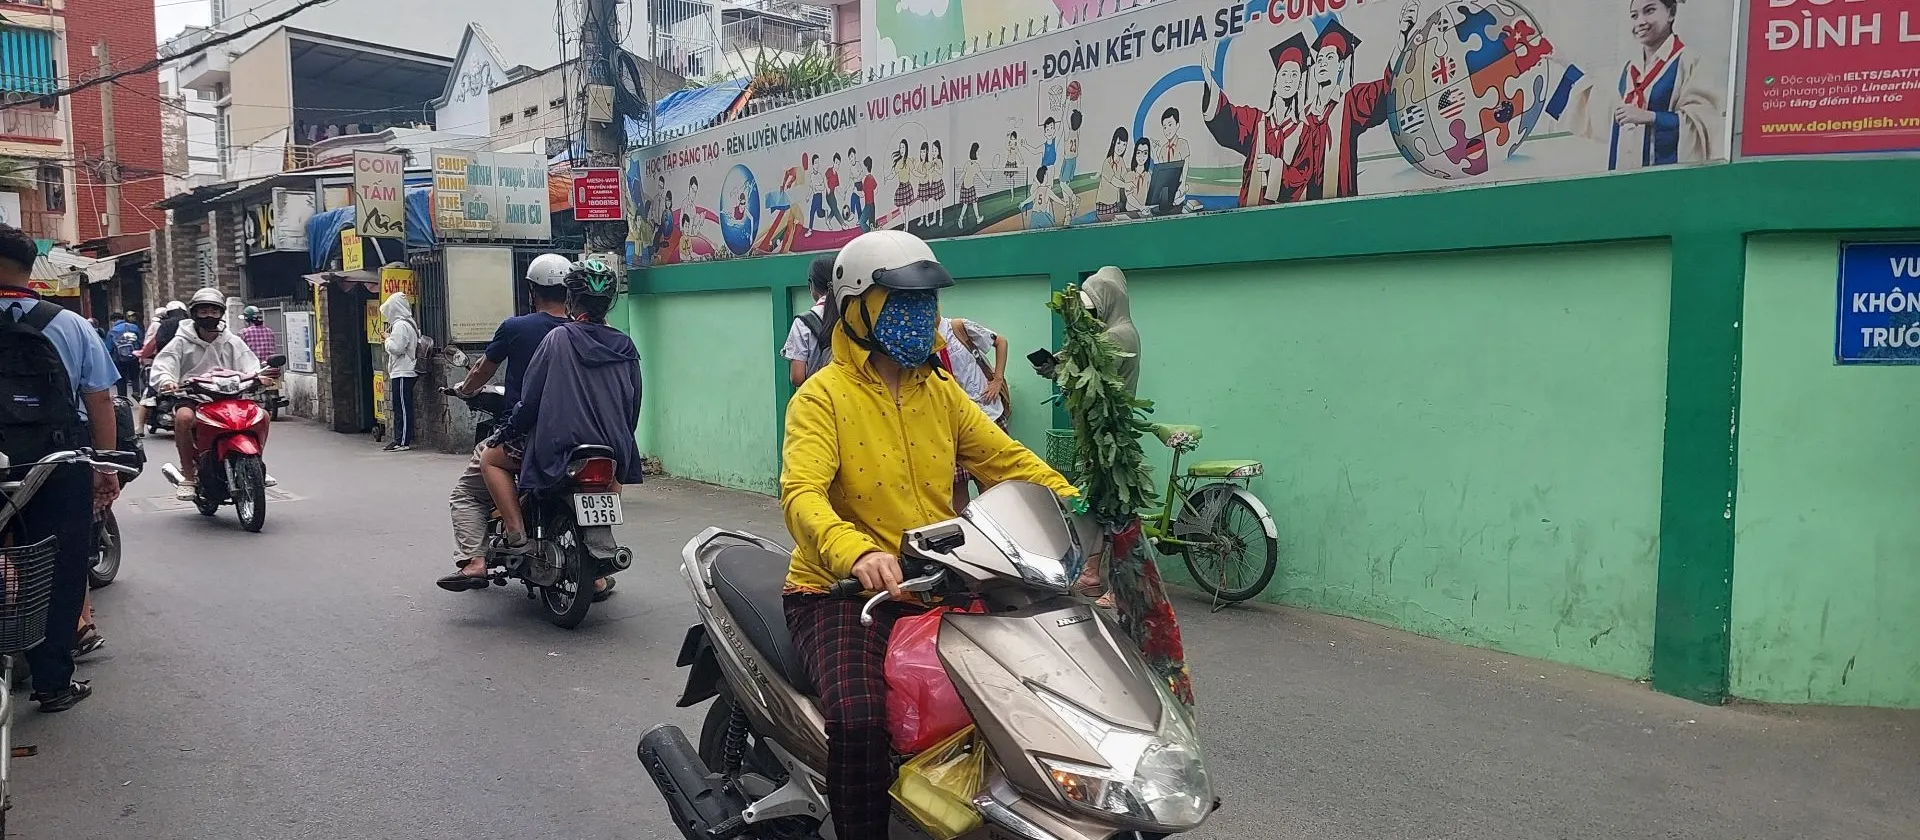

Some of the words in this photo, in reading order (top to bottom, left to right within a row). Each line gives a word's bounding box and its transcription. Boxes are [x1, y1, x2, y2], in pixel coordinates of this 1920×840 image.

[1765, 10, 1881, 50] ĐÌNH
[1781, 75, 1803, 85] Độc
[1806, 72, 1841, 85] quyền
[645, 157, 661, 179] HỌC
[663, 150, 677, 175] TẬP
[679, 145, 700, 167] SÁNG
[702, 141, 720, 166] TẠO
[727, 132, 745, 155] RÈN
[747, 123, 778, 153] LUYỆN
[780, 115, 811, 142] CHĂM
[814, 105, 856, 135] NGOAN
[867, 97, 889, 120] VUI
[893, 83, 927, 116] CHƠI
[931, 75, 971, 106] LÀNH
[976, 61, 1027, 99] MẠNH
[1043, 40, 1099, 79] ĐOÀN
[1106, 22, 1146, 65] KẾT
[1151, 16, 1207, 53] CHIA
[1783, 86, 1825, 98] phương
[1829, 84, 1858, 96] pháp
[1762, 99, 1786, 111] giúp
[1790, 98, 1817, 109] tăng
[1761, 115, 1920, 133] www.dolenglish.vn
[358, 156, 399, 174] CƠM
[362, 180, 396, 201] TẤM
[581, 495, 614, 508] 60-S9
[584, 510, 616, 523] 1356
